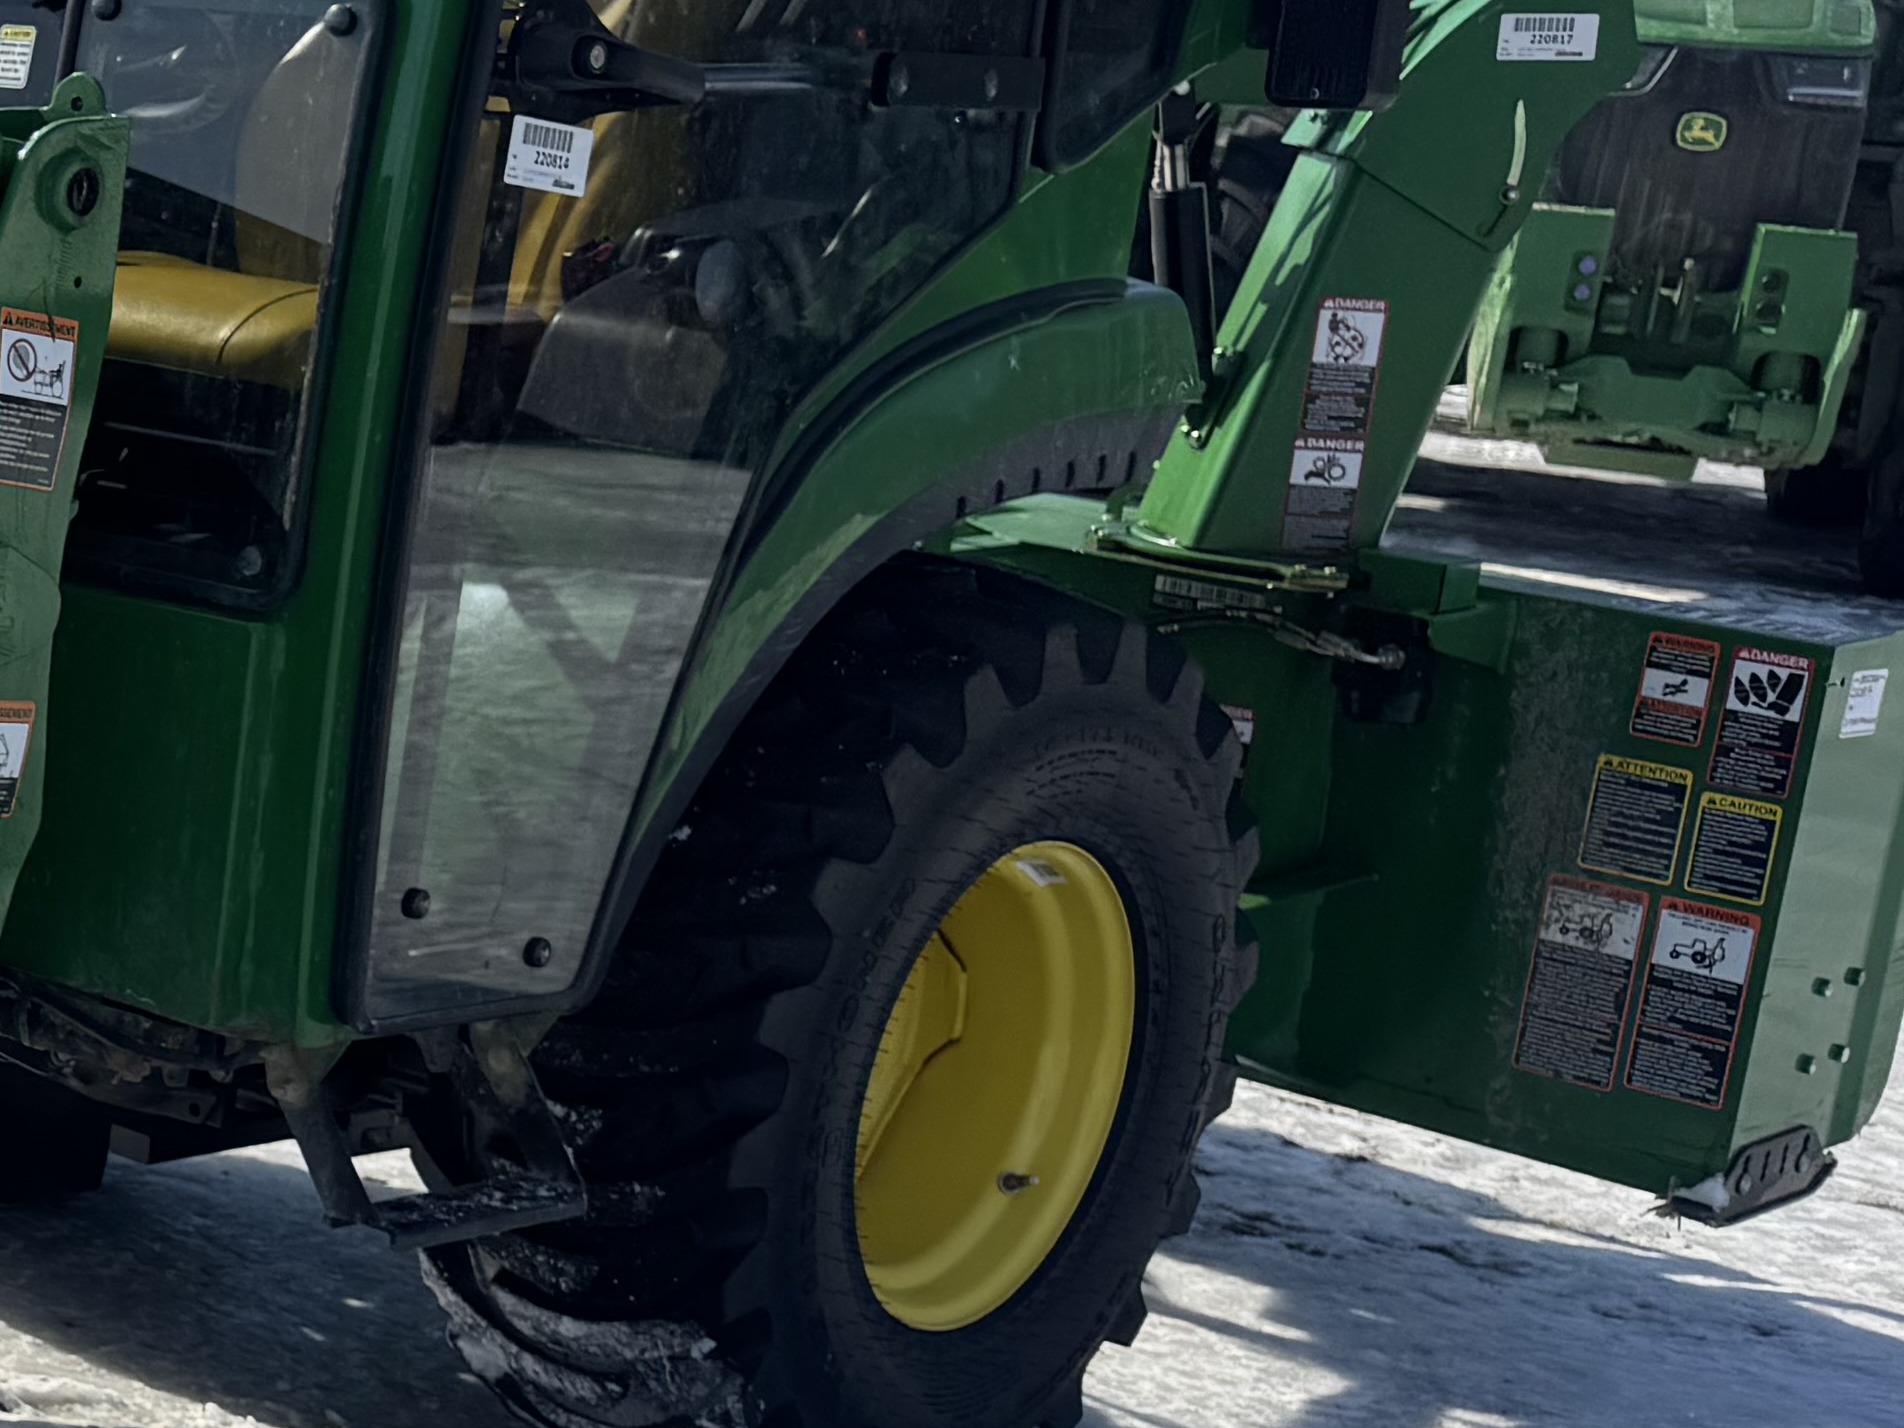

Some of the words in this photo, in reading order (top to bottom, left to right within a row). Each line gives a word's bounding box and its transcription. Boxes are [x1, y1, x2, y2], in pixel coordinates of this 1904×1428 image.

[1307, 437, 1365, 452] DANGER
[1751, 648, 1809, 669] DANGER
[1617, 761, 1688, 783] ATTENTION
[1719, 797, 1778, 818] CAUTION
